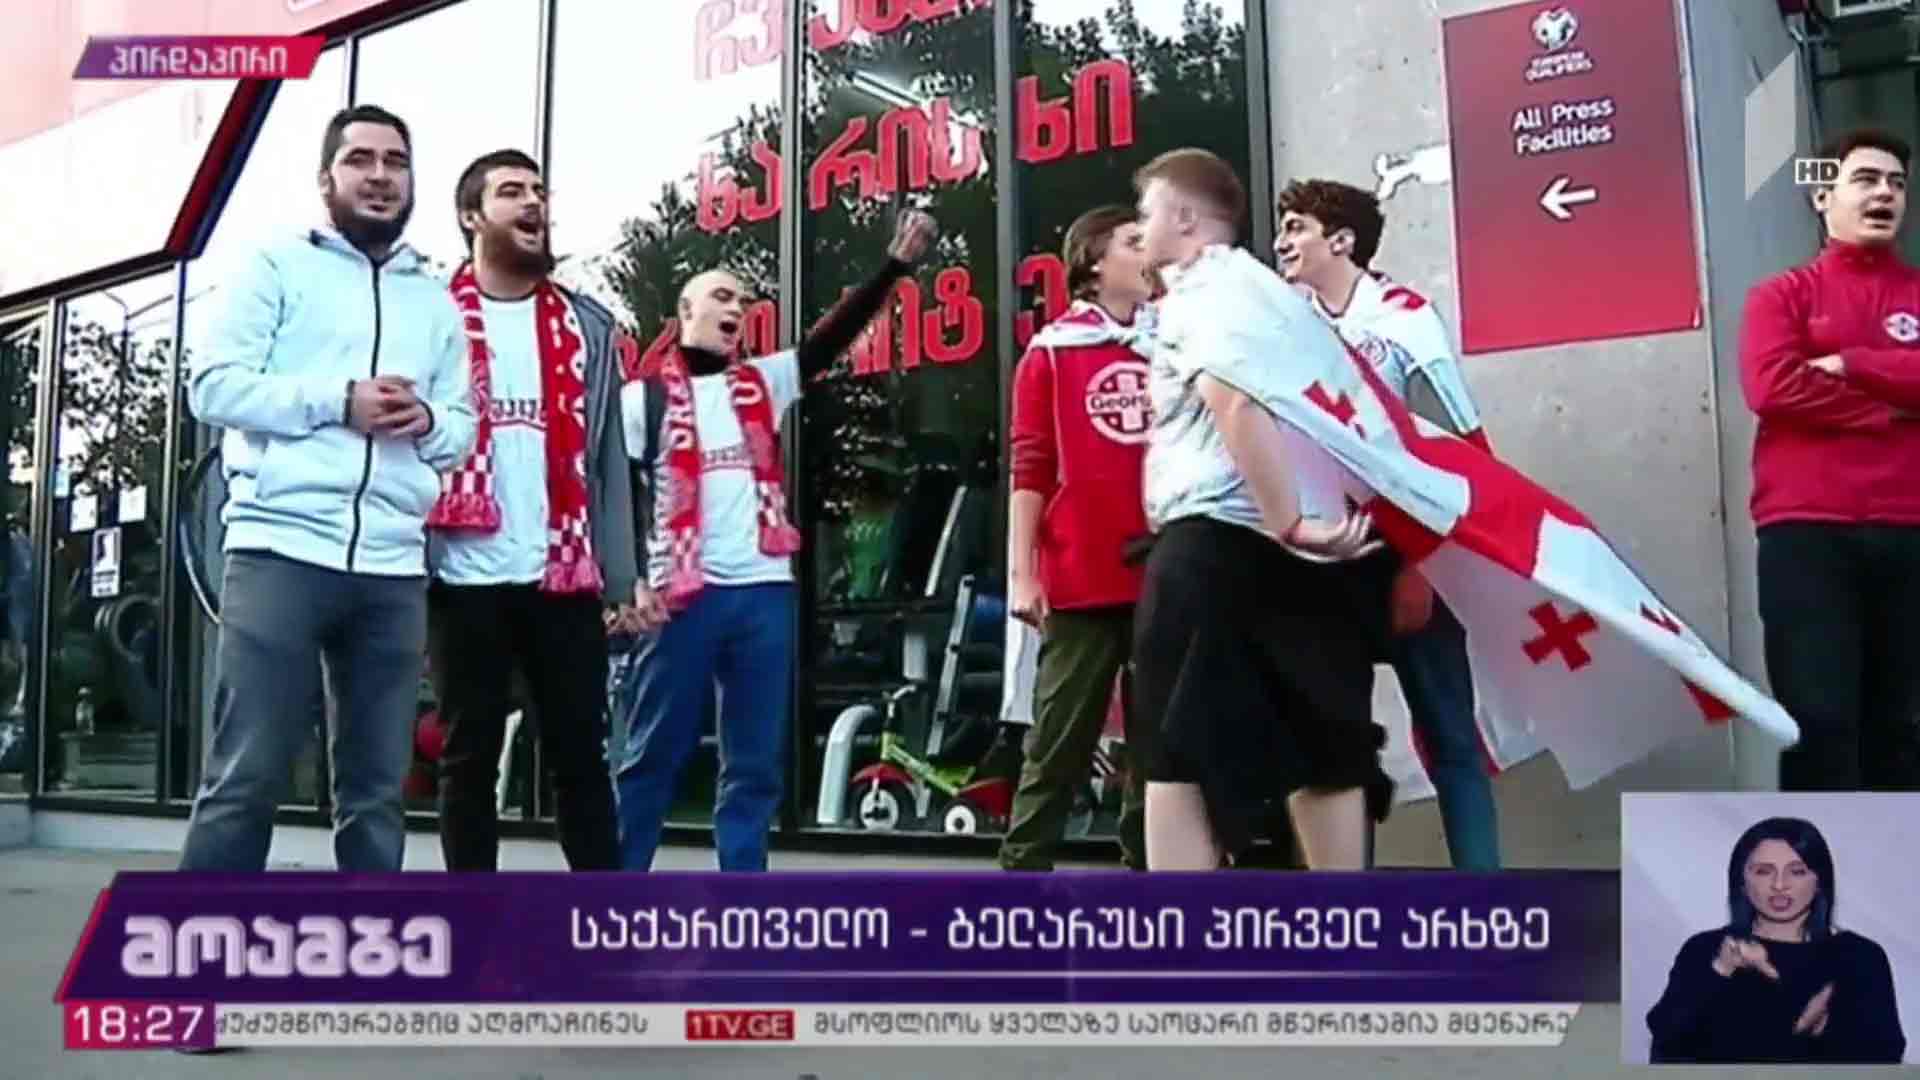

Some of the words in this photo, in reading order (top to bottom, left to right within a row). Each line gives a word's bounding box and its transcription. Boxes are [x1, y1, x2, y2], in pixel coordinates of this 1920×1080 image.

[1513, 107, 1542, 132] All
[1551, 99, 1615, 124] Press
[1516, 122, 1613, 155] Facilities
